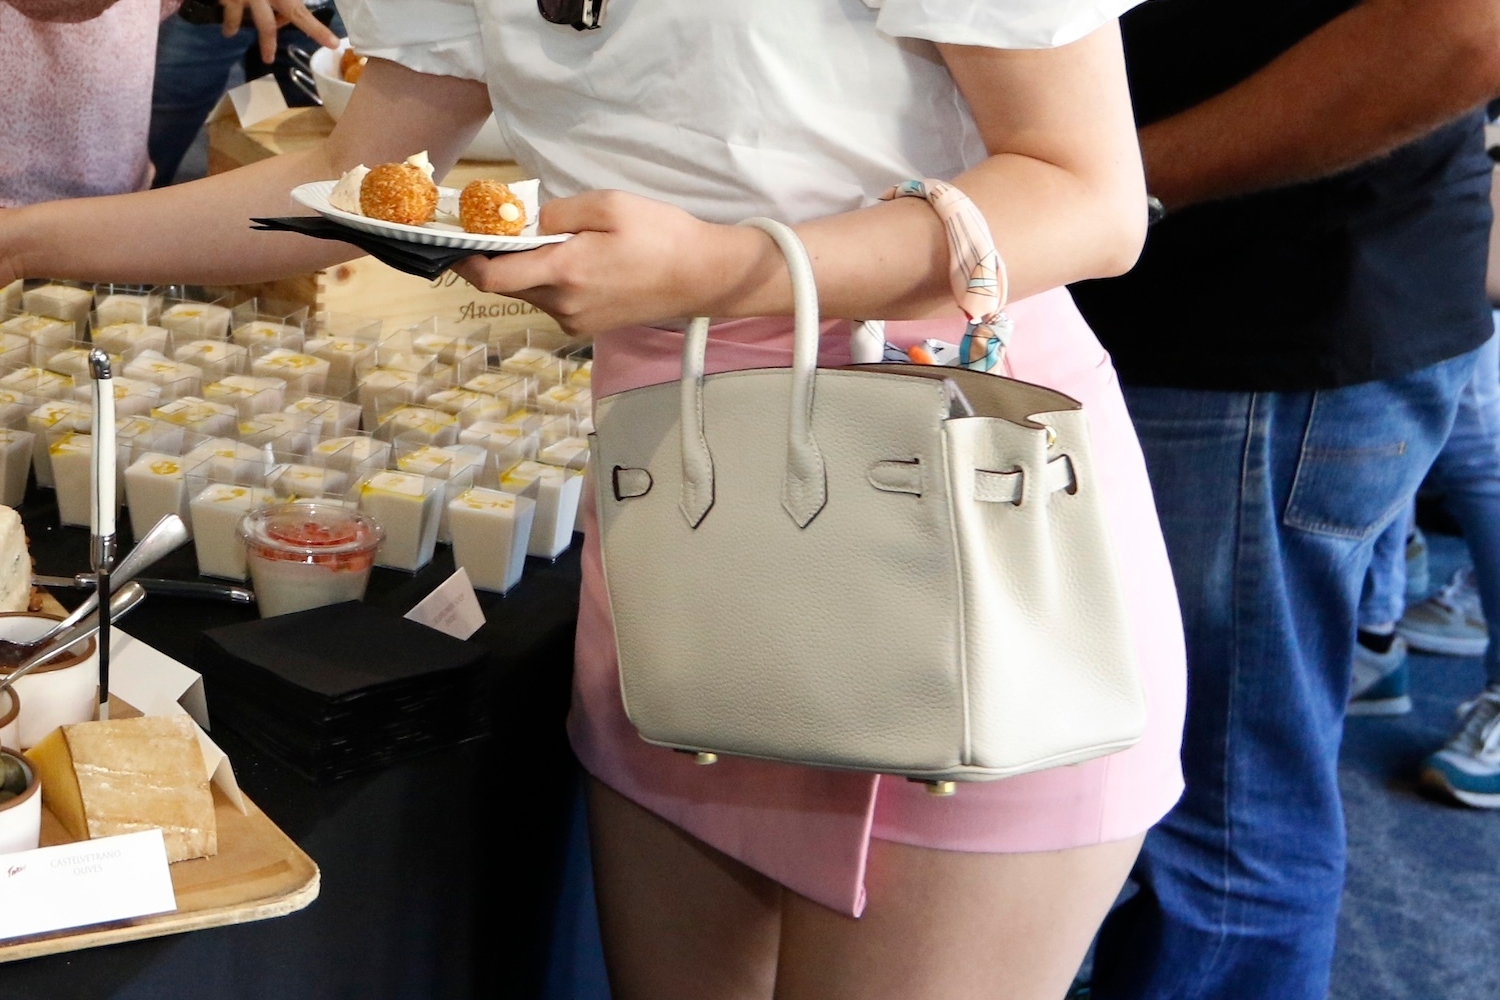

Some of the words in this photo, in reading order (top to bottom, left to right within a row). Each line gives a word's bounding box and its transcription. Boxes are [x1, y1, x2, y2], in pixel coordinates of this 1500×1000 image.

[454, 301, 543, 324] ARGIOLA
[50, 849, 122, 869] CASTELVETRANO
[72, 863, 104, 877] OLIVES
